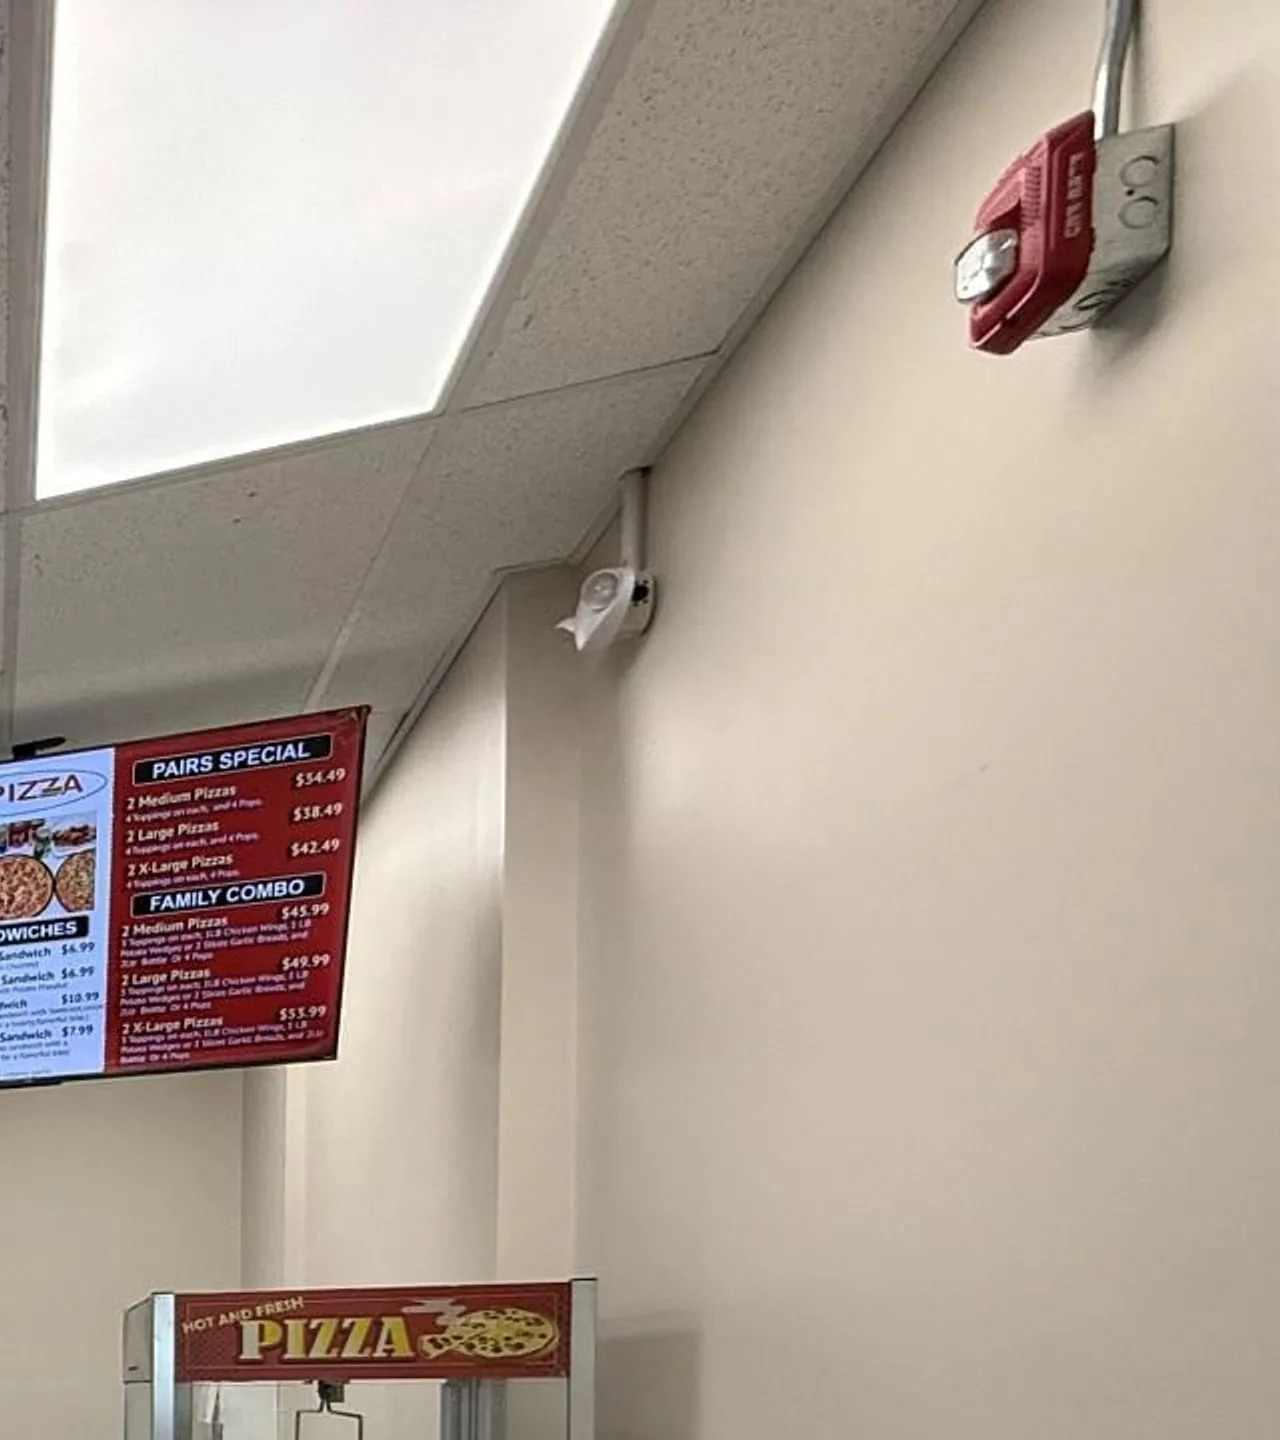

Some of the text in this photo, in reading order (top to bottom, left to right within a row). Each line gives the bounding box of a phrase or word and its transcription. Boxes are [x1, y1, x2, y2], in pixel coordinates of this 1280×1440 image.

[152, 742, 311, 779] PAIRS SPECIAL
[138, 786, 236, 808] Medium Pizzas
[138, 822, 219, 843] Large Pizzas
[192, 854, 234, 868] Pizzas
[149, 879, 305, 911] FAMILY COMBO
[133, 917, 228, 935] Medium Pizzas
[132, 972, 167, 986] Large
[170, 968, 211, 981] Pizzas
[182, 1296, 304, 1333] HOT AND FRESH
[239, 1314, 416, 1361] PIZZA
